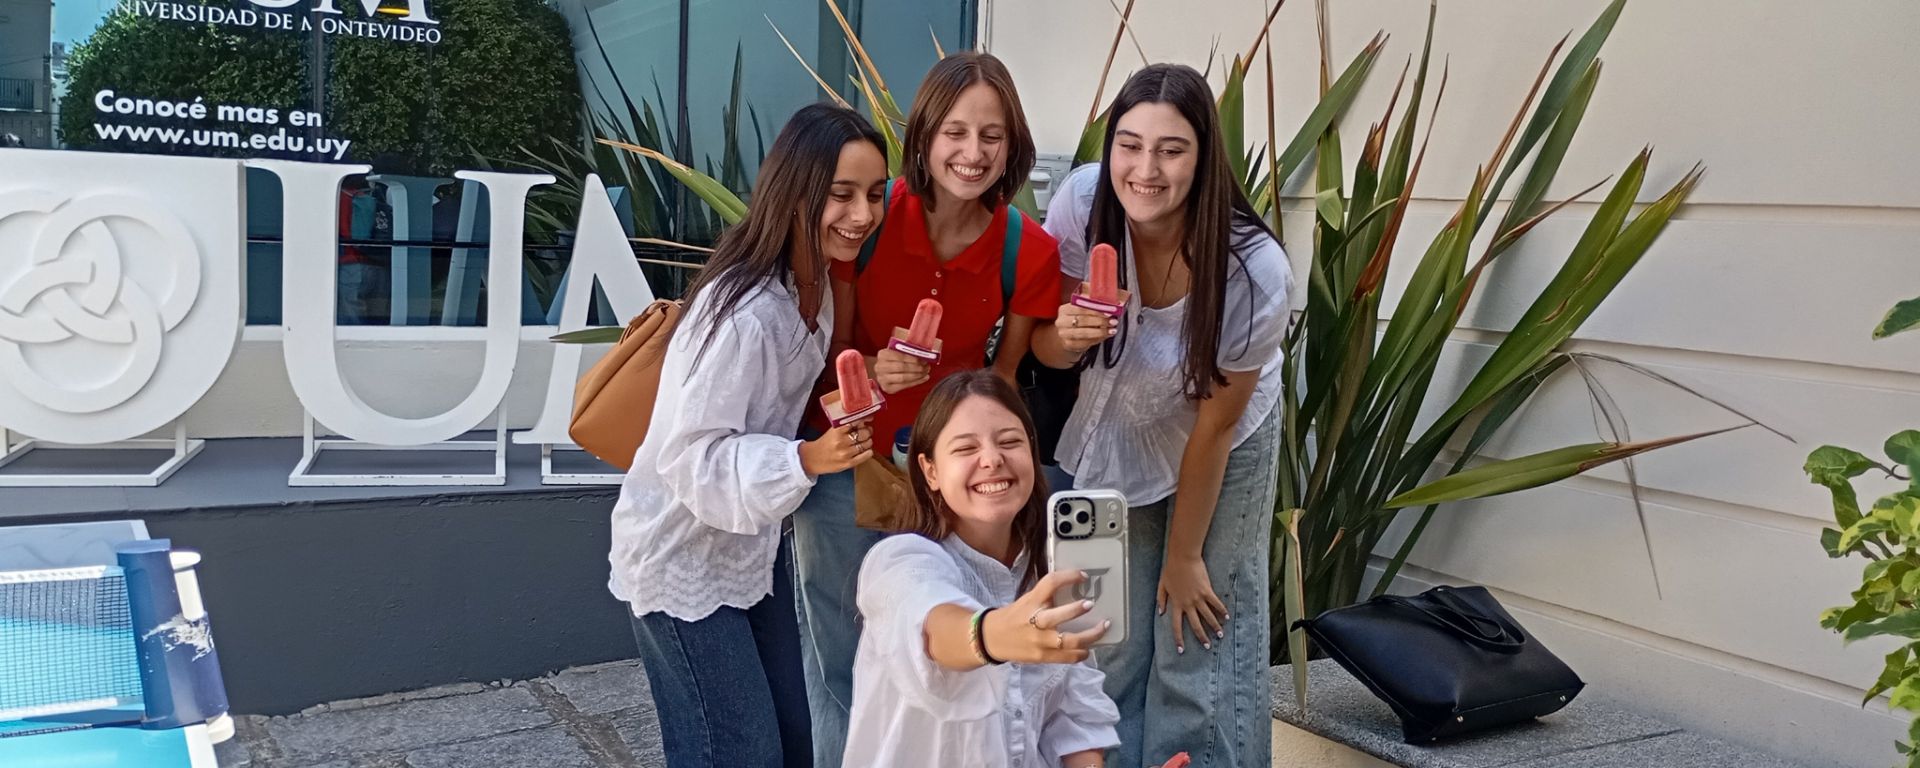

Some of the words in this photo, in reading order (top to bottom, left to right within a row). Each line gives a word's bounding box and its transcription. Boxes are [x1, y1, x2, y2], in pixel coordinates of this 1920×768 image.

[98, 0, 257, 27] NIVERSIDAD
[264, 12, 293, 30] DE
[95, 89, 207, 120] Conocé
[217, 104, 279, 125] mas
[289, 110, 322, 127] en
[93, 123, 351, 160] www.um.edu.uy
